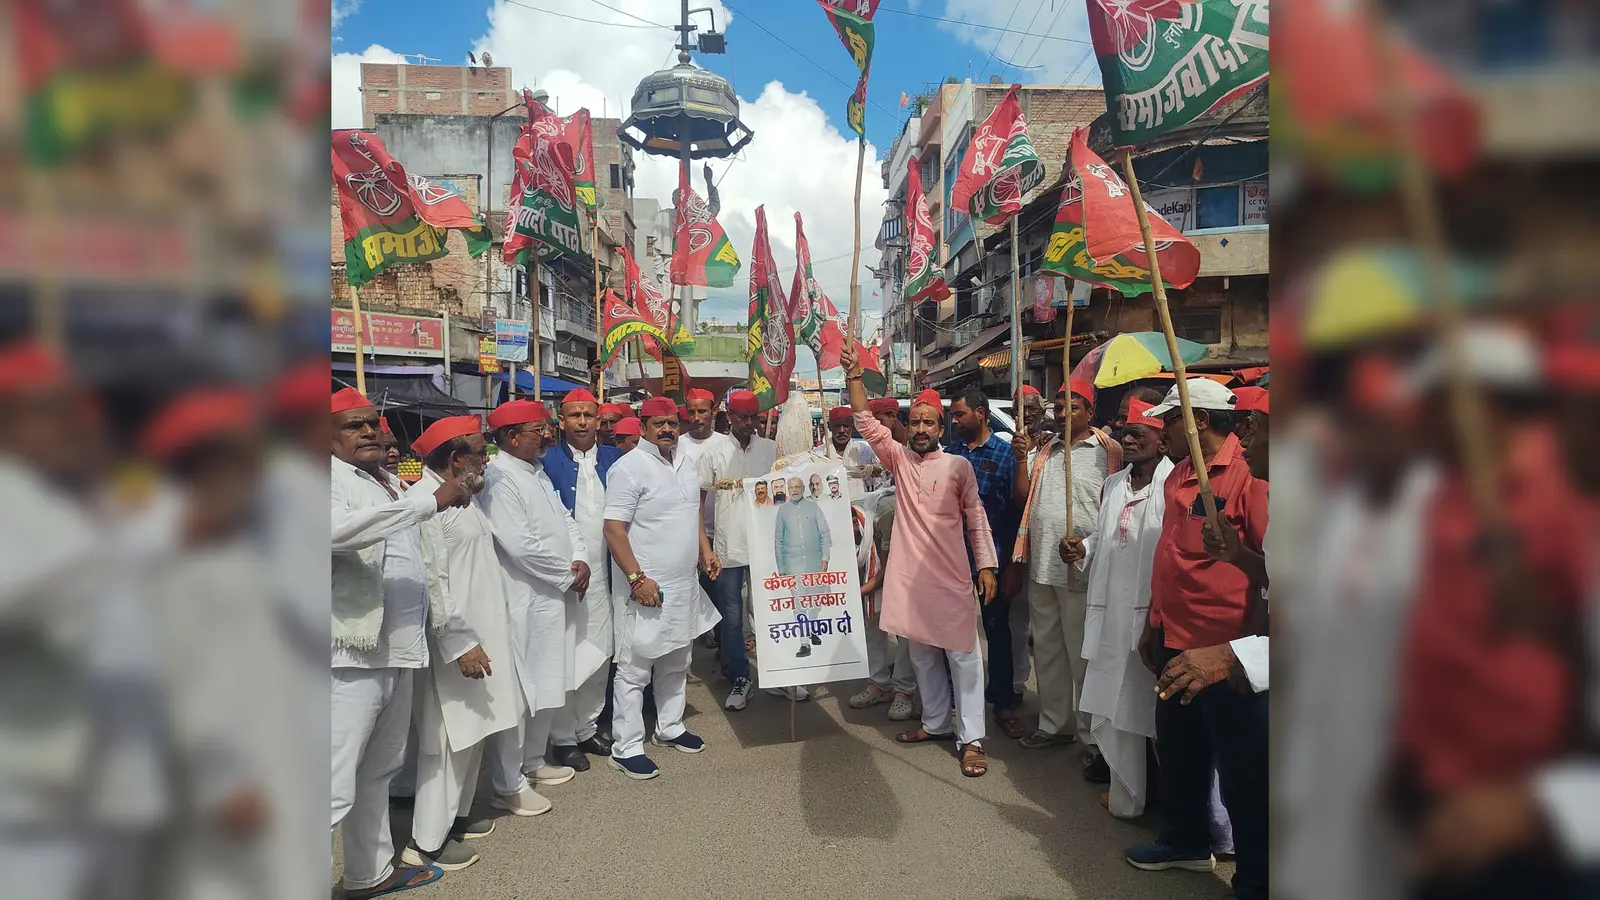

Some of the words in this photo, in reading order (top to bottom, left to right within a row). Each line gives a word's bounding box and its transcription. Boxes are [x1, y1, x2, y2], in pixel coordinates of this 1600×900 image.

[362, 221, 447, 270] समाज
[762, 572, 798, 590] केन्द्र
[800, 572, 848, 586] सरकार
[768, 597, 796, 611] राज
[799, 593, 847, 608] सरकार
[768, 613, 833, 643] इस्तीफा
[835, 610, 852, 635] दो
